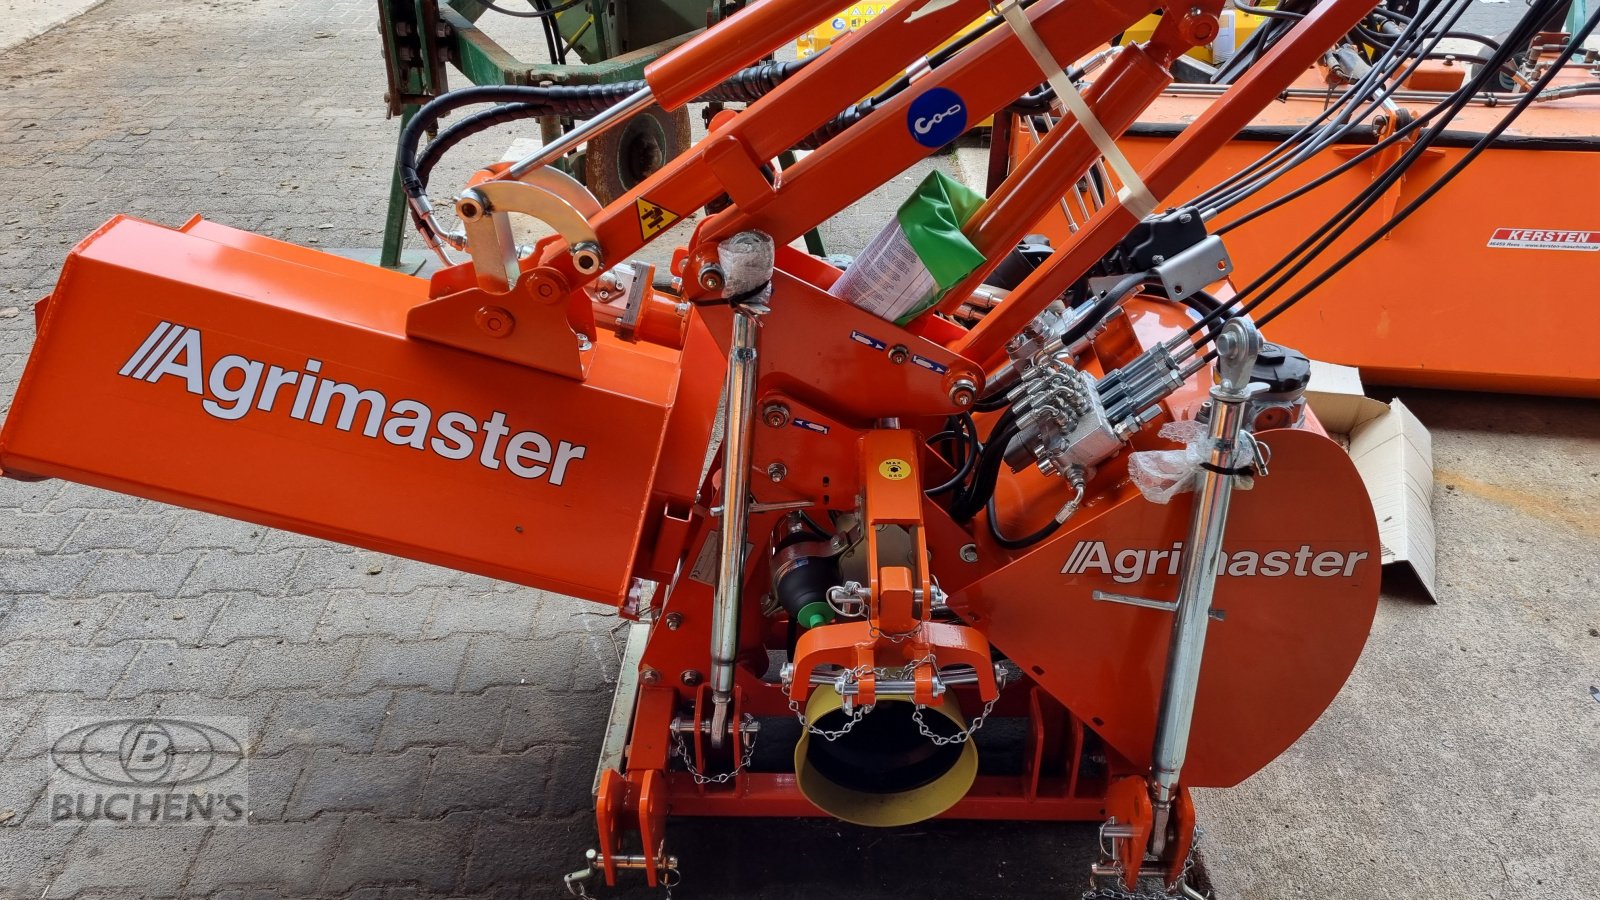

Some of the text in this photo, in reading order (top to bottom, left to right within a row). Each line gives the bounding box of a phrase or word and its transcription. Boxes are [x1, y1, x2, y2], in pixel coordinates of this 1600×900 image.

[1508, 230, 1590, 242] KERSTEN
[142, 322, 587, 487] Agrimaster
[1070, 541, 1368, 583] Agriaster
